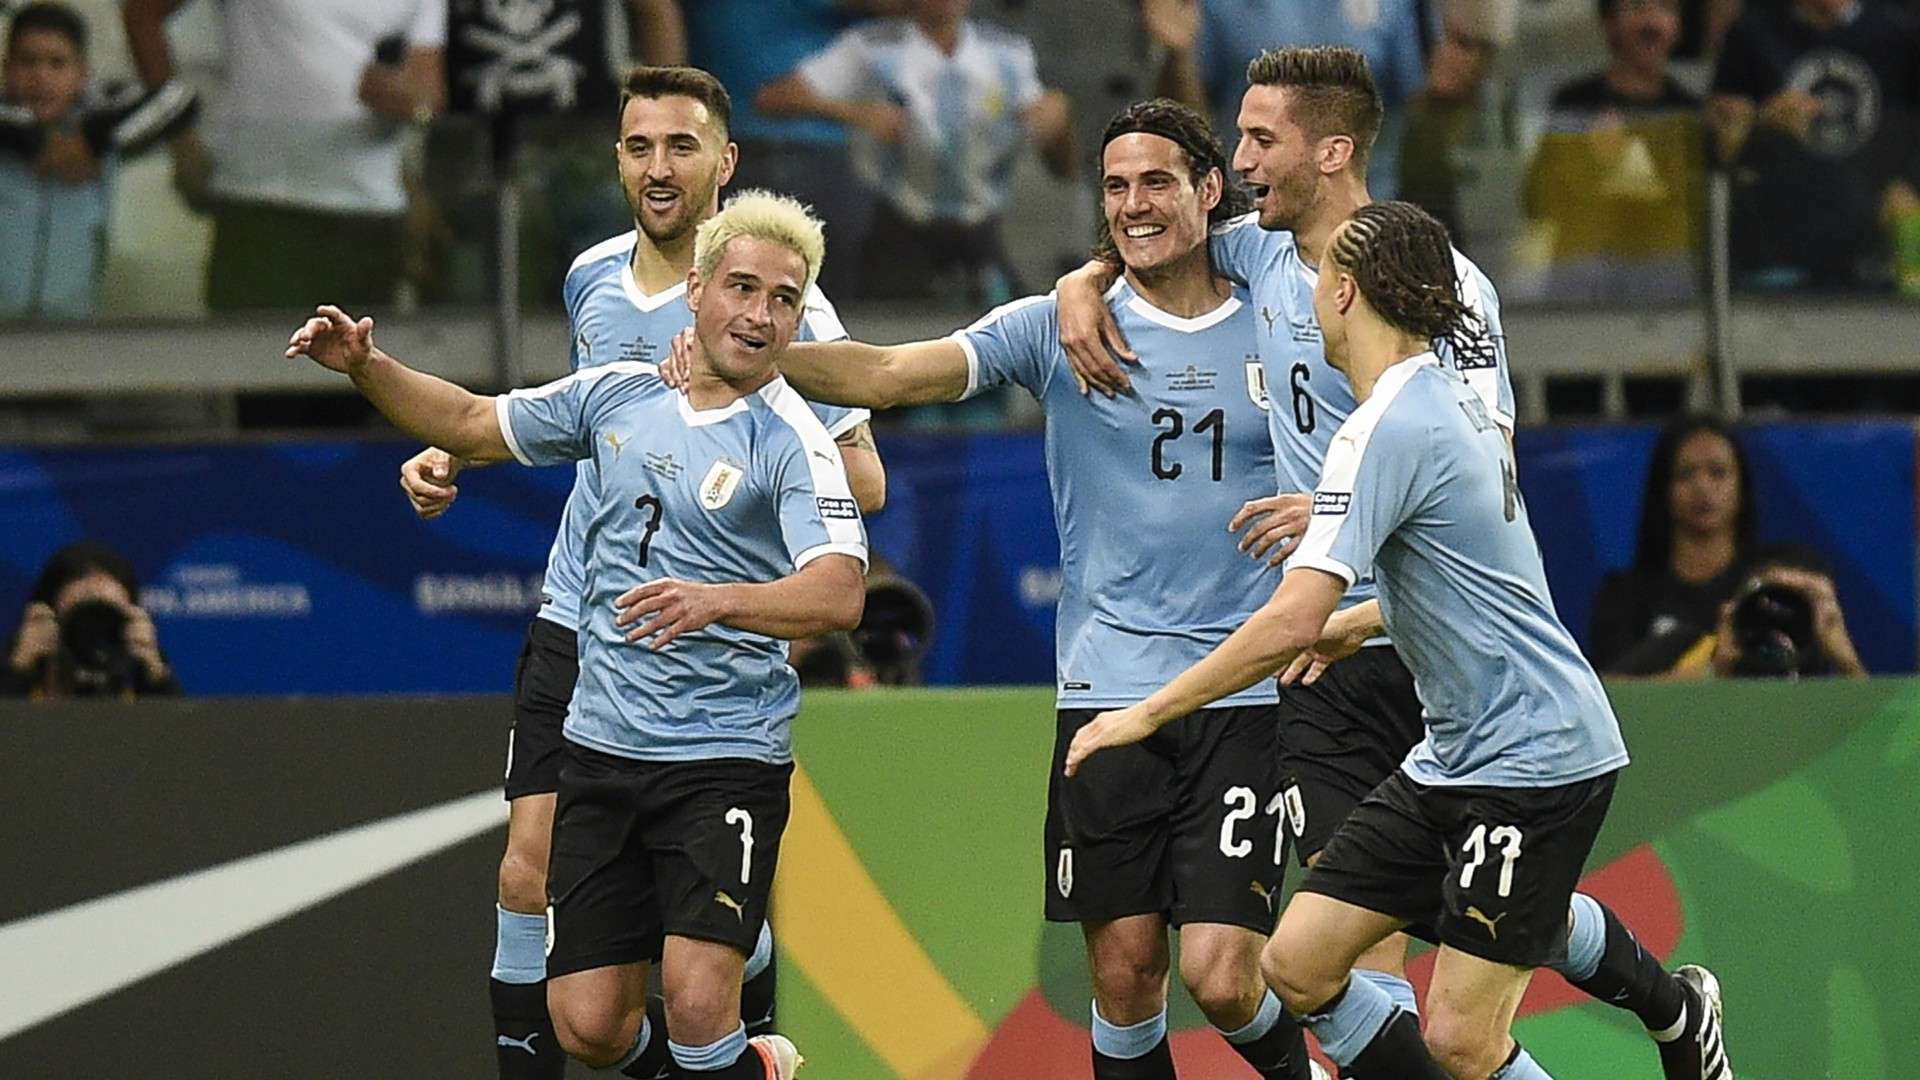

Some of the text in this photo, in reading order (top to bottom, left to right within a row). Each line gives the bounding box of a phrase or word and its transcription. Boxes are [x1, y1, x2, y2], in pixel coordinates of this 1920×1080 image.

[1290, 362, 1316, 435] 6
[1151, 407, 1225, 482] 21
[634, 493, 663, 569] 7
[725, 807, 754, 884] 7
[1218, 785, 1287, 866] 21
[1459, 824, 1524, 897] 17
